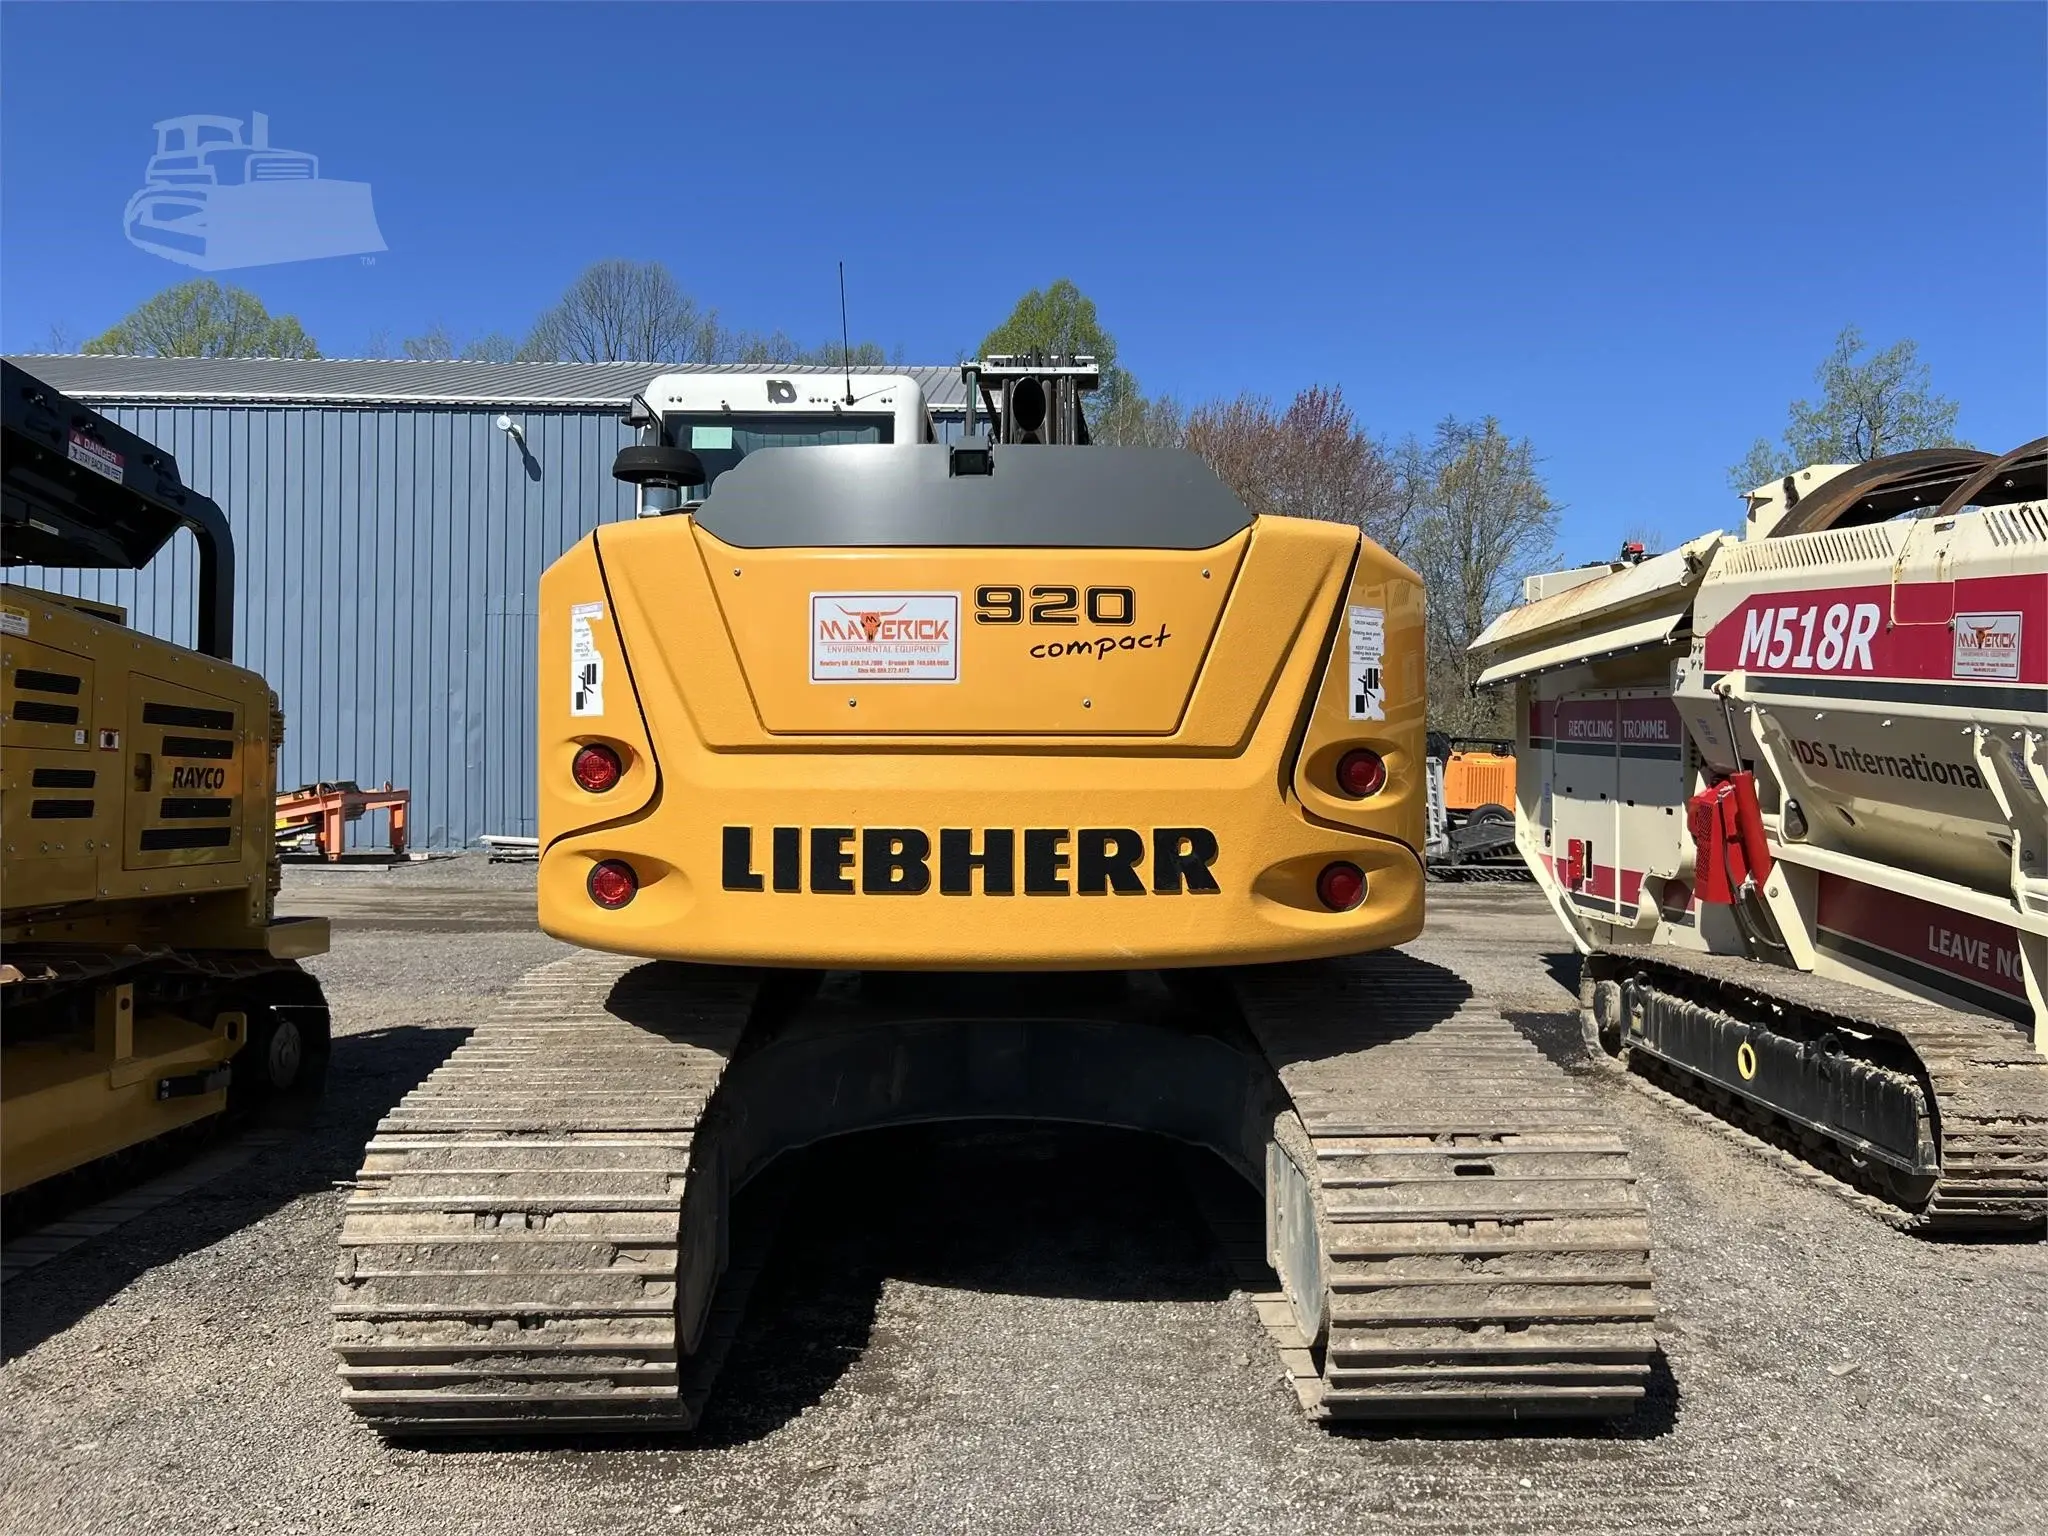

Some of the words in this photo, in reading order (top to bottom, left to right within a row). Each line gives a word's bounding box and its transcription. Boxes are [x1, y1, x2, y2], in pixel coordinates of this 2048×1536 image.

[84, 438, 117, 463] DANGER
[974, 584, 1136, 627] 920
[820, 619, 949, 642] MAVERICK
[1029, 623, 1172, 660] compact
[1738, 603, 1881, 671] M518R
[1958, 632, 2016, 648] MAVERICK
[827, 645, 892, 654] ENVIRONMENTAL
[895, 645, 941, 654] EQUIPMENT
[1568, 720, 1614, 738] RECYCLING
[1622, 720, 1670, 739] TROMMEL
[173, 766, 225, 790] RAYCO
[721, 826, 1221, 897] LIEBHERR
[1928, 925, 1991, 970] LEAVE
